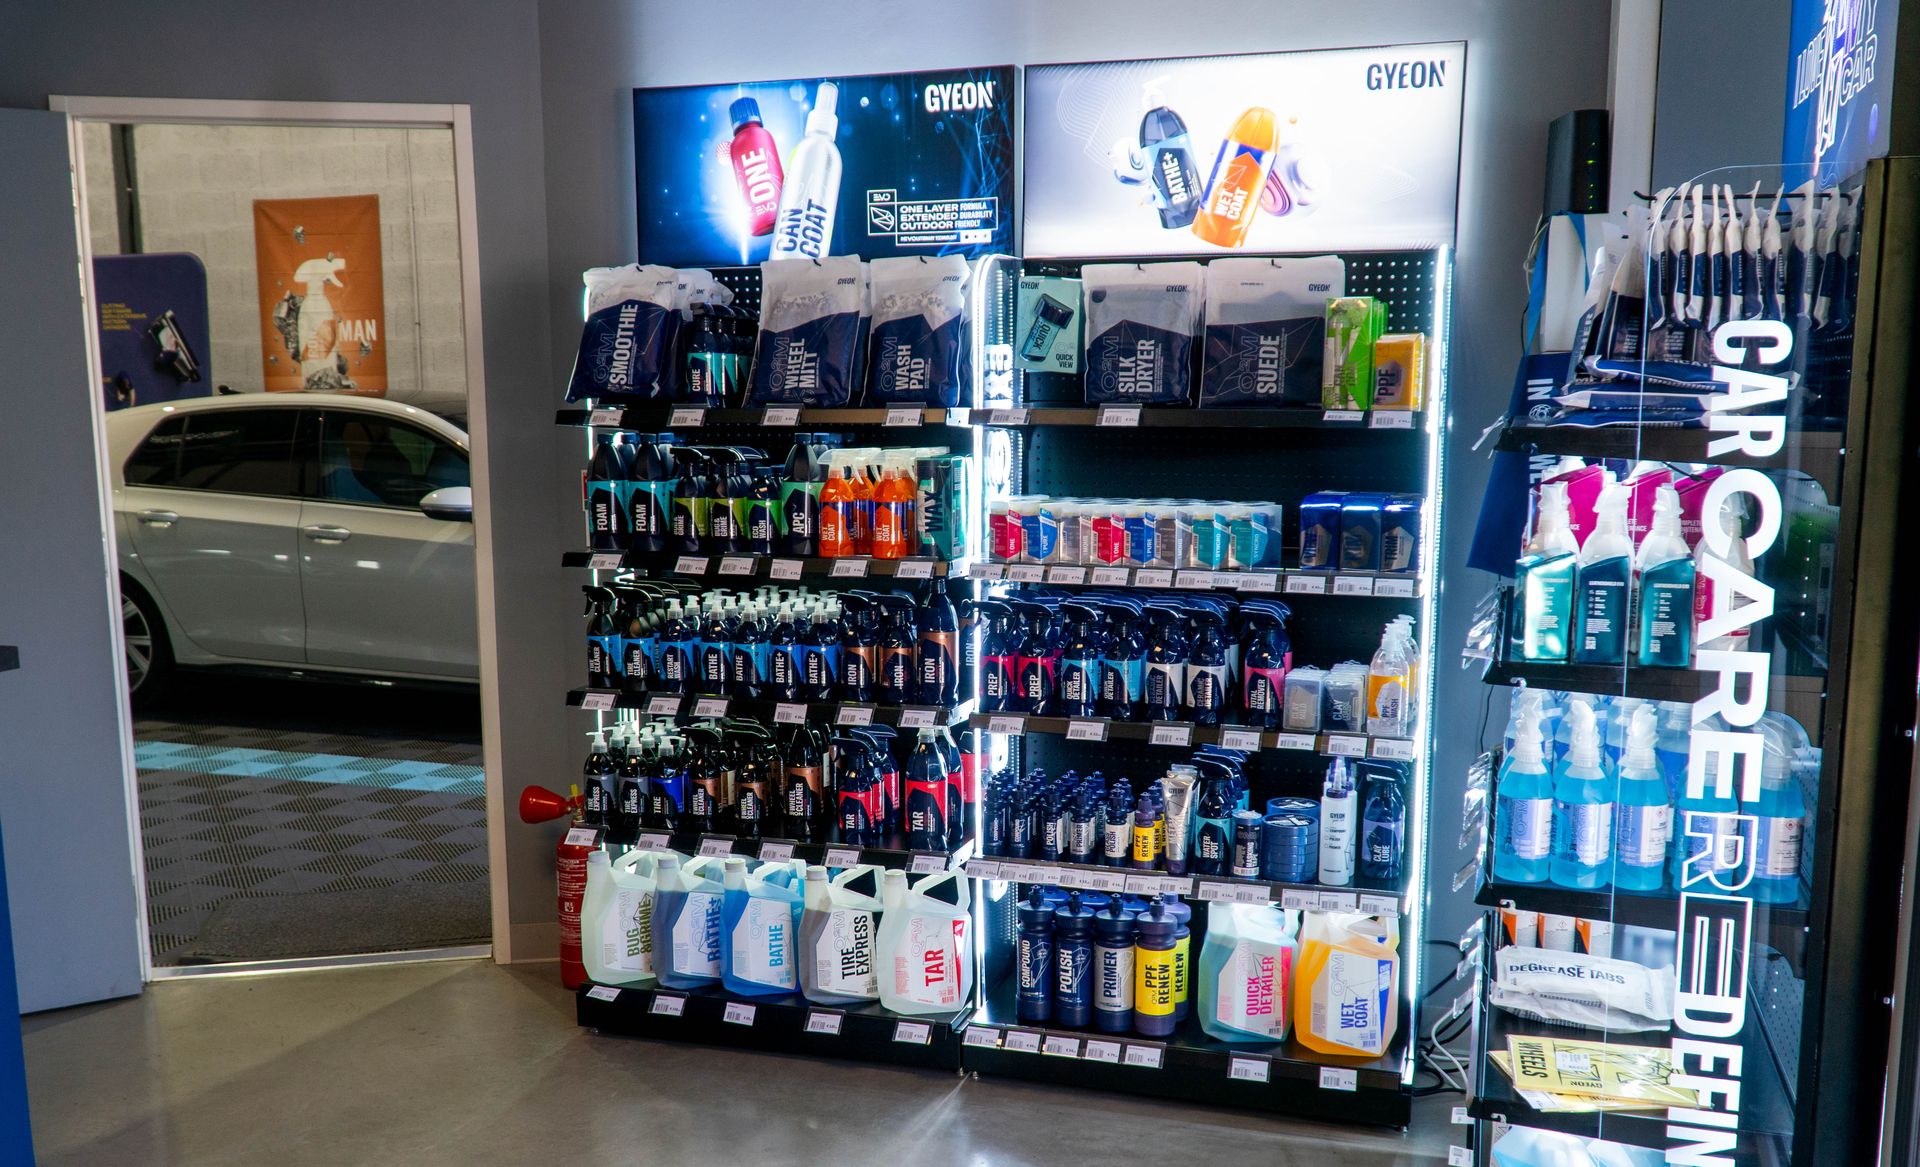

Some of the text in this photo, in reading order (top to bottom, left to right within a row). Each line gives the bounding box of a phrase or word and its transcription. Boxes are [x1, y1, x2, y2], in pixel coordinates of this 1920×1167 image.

[1366, 60, 1446, 91] GYEON
[925, 81, 994, 112] GYEON
[740, 146, 776, 204] ONE
[1162, 151, 1188, 205] BATHE+
[900, 205, 924, 214] ONE
[925, 203, 958, 213] LAYER
[901, 212, 959, 222] EXTENDED
[1214, 187, 1249, 221] WET COAT
[776, 198, 827, 258] CAN COAT
[901, 221, 953, 231] OUTDOOR
[338, 319, 377, 342] MAN
[608, 304, 638, 385] SMOOTHIE
[784, 338, 818, 390] WHEEL MITT
[895, 344, 925, 391] WASH PAD
[1055, 353, 1074, 362] QUICK
[1058, 361, 1073, 369] VIEW
[1118, 339, 1155, 393] SILK DRYER
[1256, 335, 1281, 394] SUEDE
[692, 368, 701, 392] CURE
[1707, 319, 1793, 458] CAR
[597, 503, 608, 531] FOAM
[636, 504, 647, 532] FOAM
[792, 512, 805, 534] APC
[925, 490, 944, 532] WAX
[758, 519, 767, 539] WASH
[827, 523, 836, 541] COAT
[882, 524, 890, 542] COAT
[708, 653, 718, 680] BATHE
[736, 654, 744, 682] BATHE
[775, 652, 785, 684] BATHE+
[809, 652, 818, 684] BATHE+
[965, 642, 975, 667] IRON
[847, 663, 857, 686] IRON
[893, 665, 904, 687] IRON
[924, 657, 936, 684] IRON
[988, 673, 998, 696] PREP
[1029, 674, 1039, 698] PREP
[1072, 671, 1081, 700] DETAILER
[1156, 674, 1164, 705] DETAILER
[1204, 677, 1212, 707] DETAILER
[1257, 679, 1266, 710] REMOVER
[1332, 700, 1343, 721] CLAY
[1391, 698, 1399, 719] WASH
[593, 786, 601, 812] EXPRESS
[630, 788, 638, 814] EXPRESS
[653, 796, 661, 814] TIRE
[795, 782, 804, 812] CLEANER
[845, 813, 855, 830] TAR
[912, 811, 924, 832] TAR
[1046, 822, 1055, 846] POLISH
[1075, 824, 1084, 848] PRIMER
[1202, 835, 1218, 859] WATER SPOT
[1373, 843, 1390, 863] CLAY LUBE
[626, 928, 640, 957] BUG
[706, 896, 721, 962] BATHE+
[769, 924, 784, 968] BATHE
[841, 914, 870, 980] TIRE EXPRESS
[924, 948, 945, 987] TAR
[1021, 940, 1031, 988] COMPOUND
[1059, 949, 1073, 993] POLISH
[1103, 950, 1118, 998] PRIMER
[1175, 953, 1184, 992] RENEW
[1509, 962, 1625, 985] DEGREASE TABS
[1144, 963, 1170, 1005] PPF RENEW
[1246, 955, 1275, 1016] QUICK DETAILER
[1341, 996, 1368, 1029] WET COAT
[1518, 1042, 1548, 1079] WHEELS
